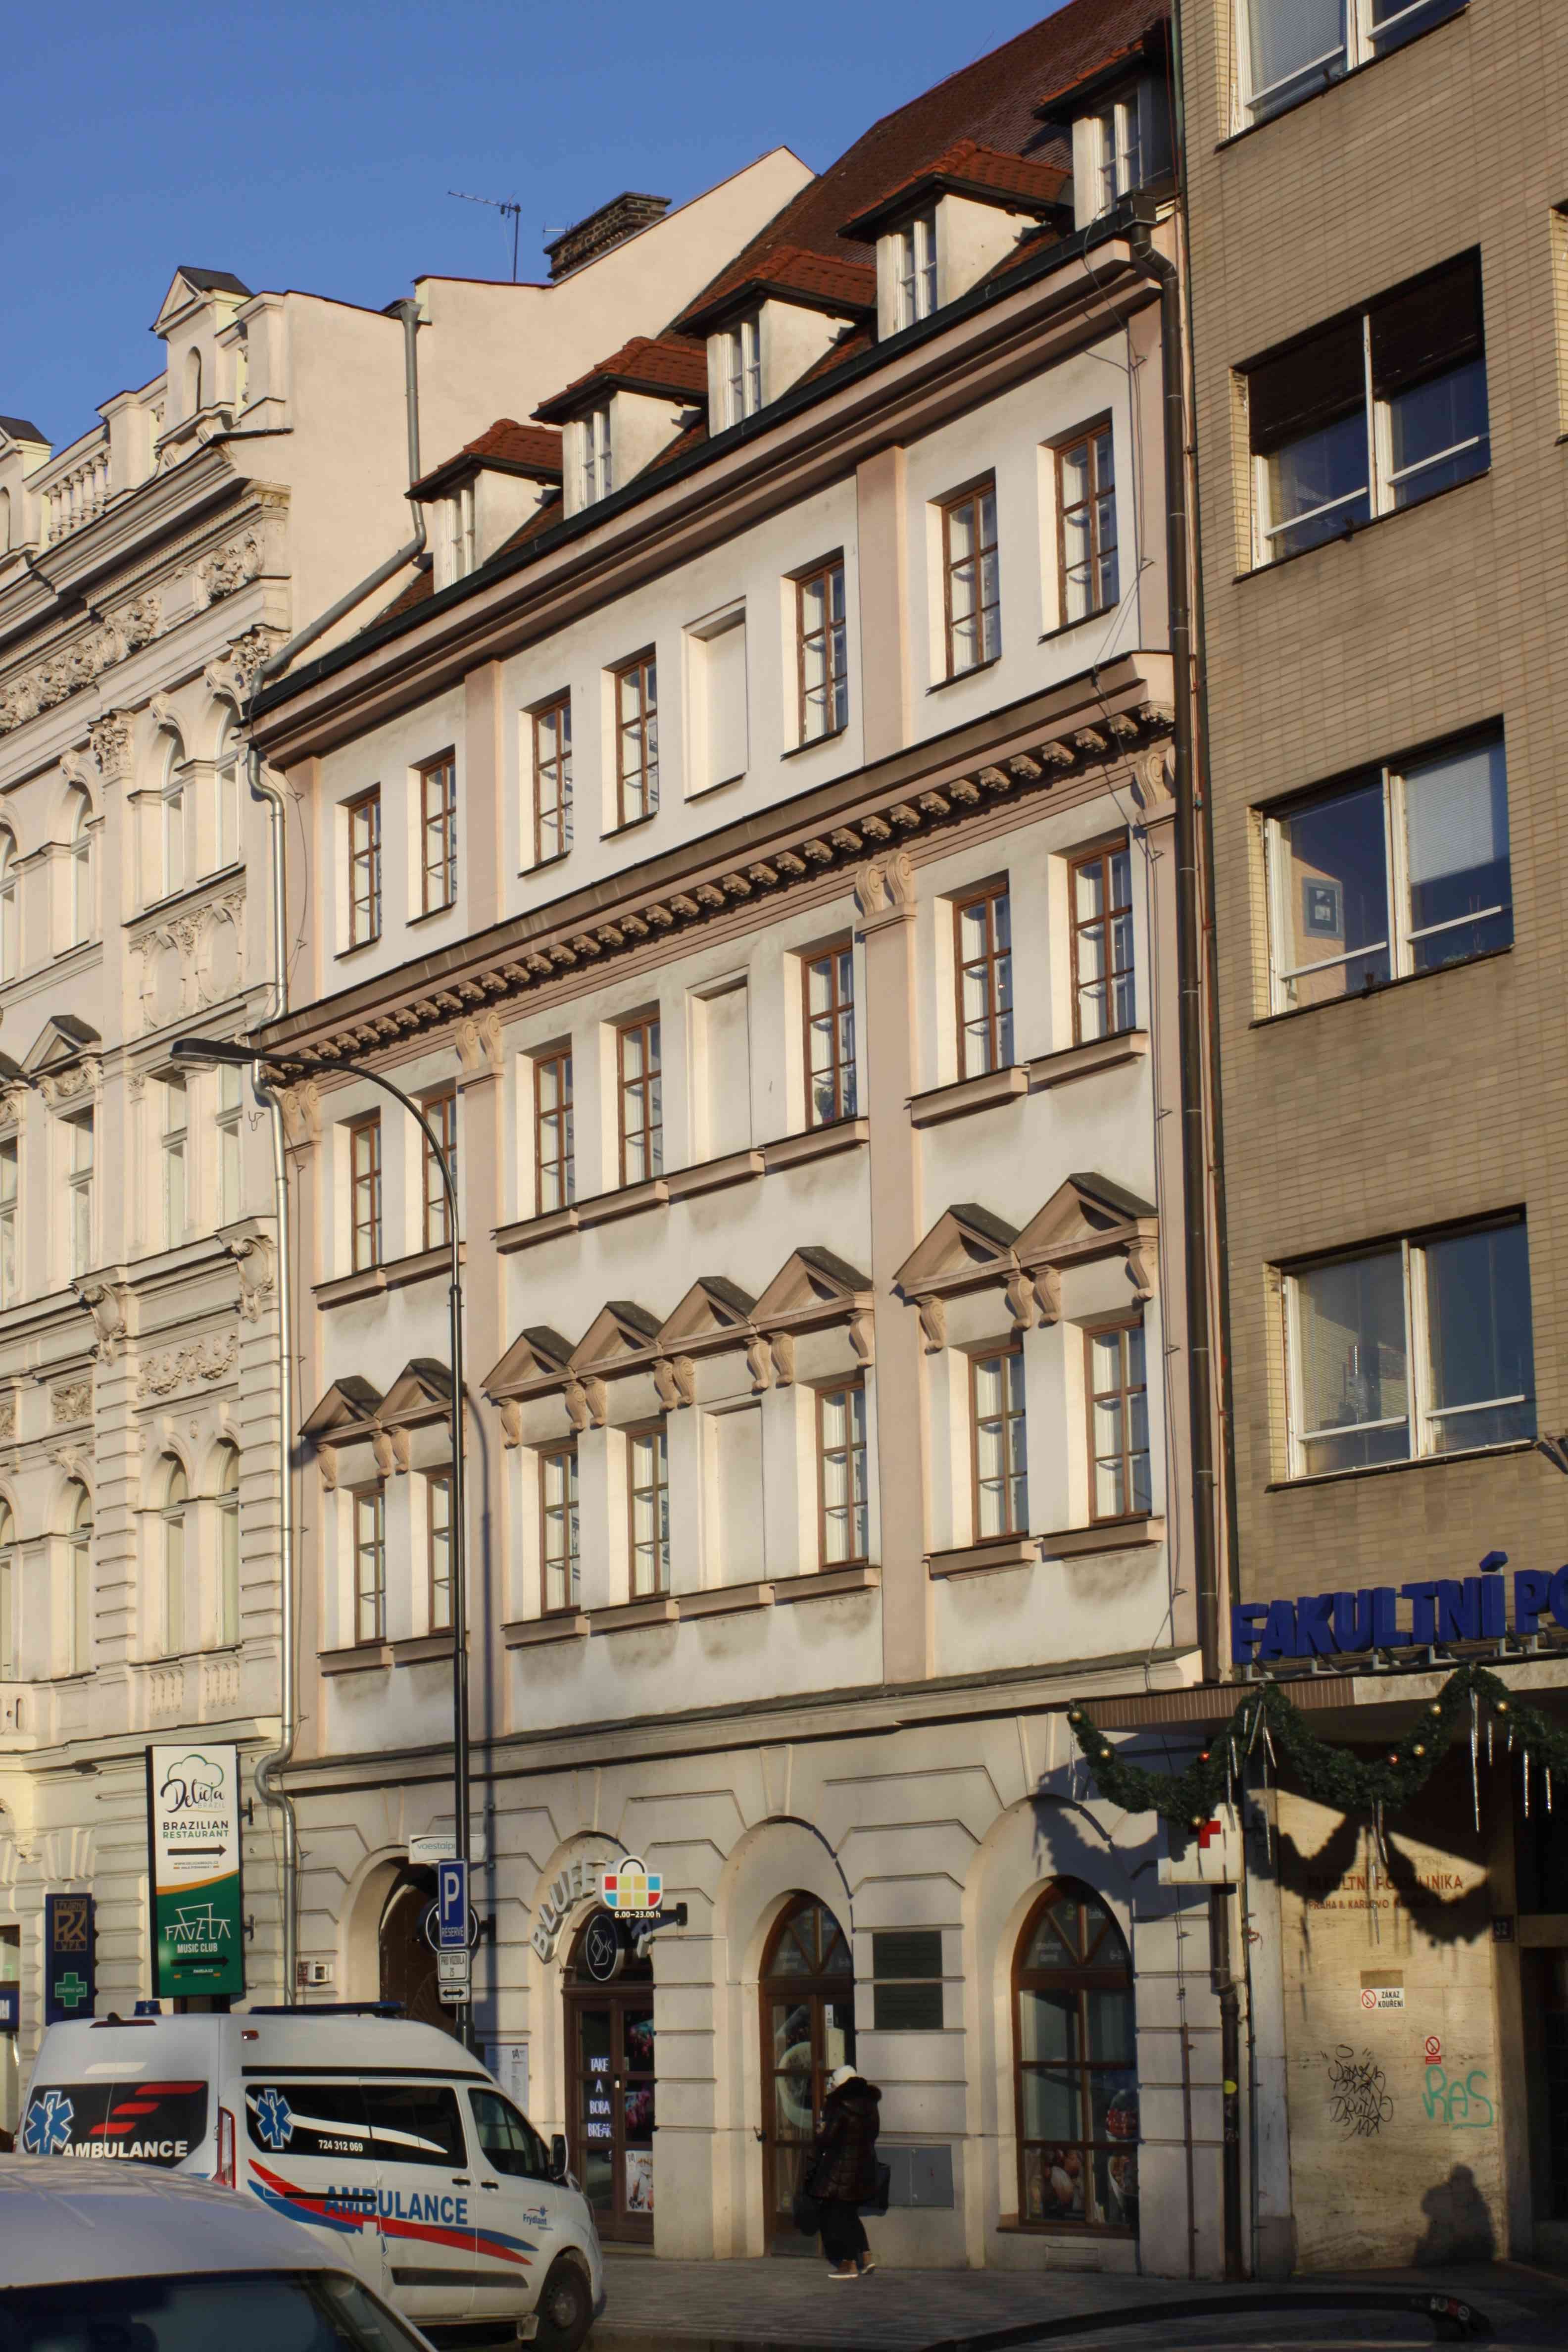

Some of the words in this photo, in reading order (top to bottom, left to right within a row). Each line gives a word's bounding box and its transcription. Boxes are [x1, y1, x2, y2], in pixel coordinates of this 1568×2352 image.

[1232, 1551, 1508, 1665] FAKULTNÍ
[163, 1820, 229, 1830] BRAZILIAN
[163, 1830, 229, 1839] RESTAURANT
[443, 1872, 460, 1920] P
[164, 1903, 231, 1941] FAVELA
[177, 1943, 199, 1954] MUSIC
[200, 1943, 218, 1953] CLUB
[590, 2058, 609, 2071] TAKE
[595, 2080, 603, 2093] A
[589, 2100, 611, 2114] BOBA
[63, 2140, 188, 2158] AMBULANCE
[318, 2139, 333, 2149] 724
[334, 2141, 348, 2151] 312
[349, 2142, 363, 2152] 069
[324, 2186, 468, 2225] AMBULANCE
